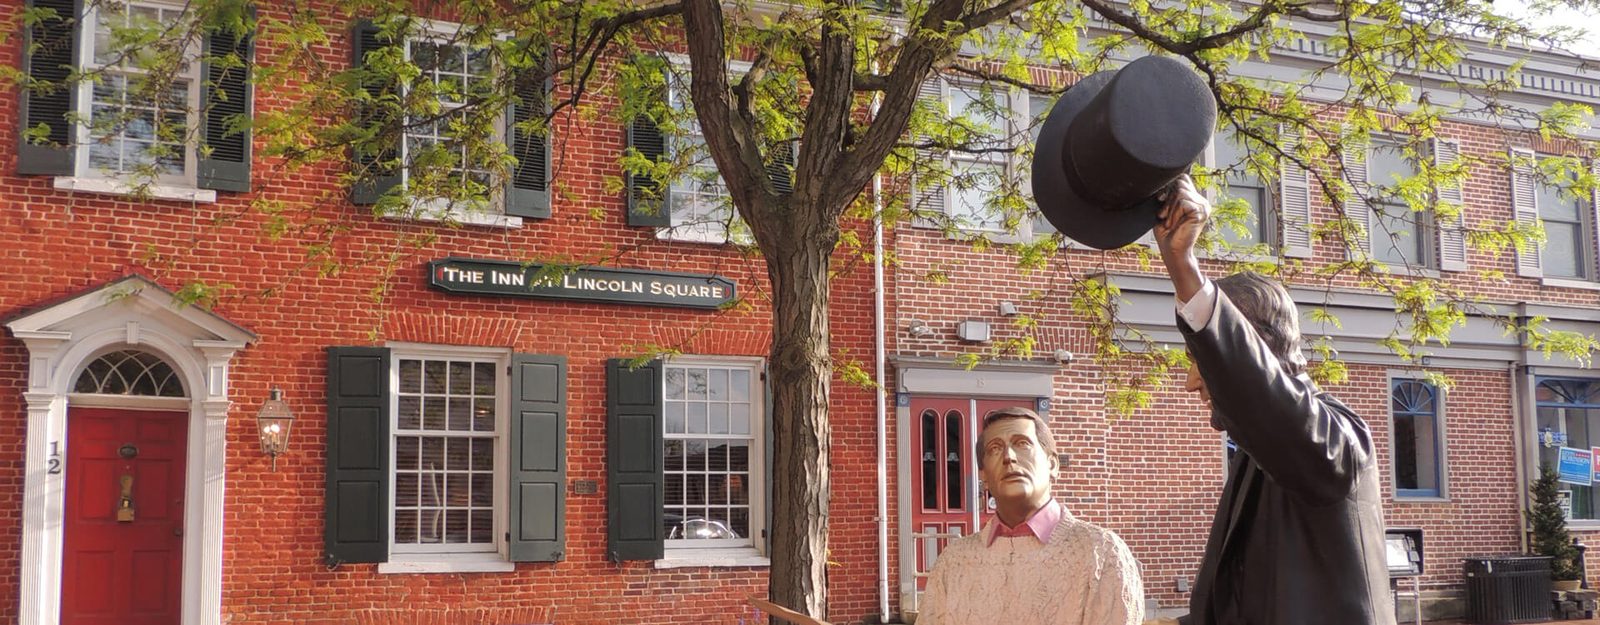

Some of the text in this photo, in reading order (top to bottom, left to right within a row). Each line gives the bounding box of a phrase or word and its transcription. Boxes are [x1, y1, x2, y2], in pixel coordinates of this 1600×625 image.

[444, 266, 484, 284] THE
[492, 270, 525, 286] INN
[564, 275, 643, 293] LINCOLN
[650, 281, 723, 298] SQUARE
[47, 441, 61, 474] 12
